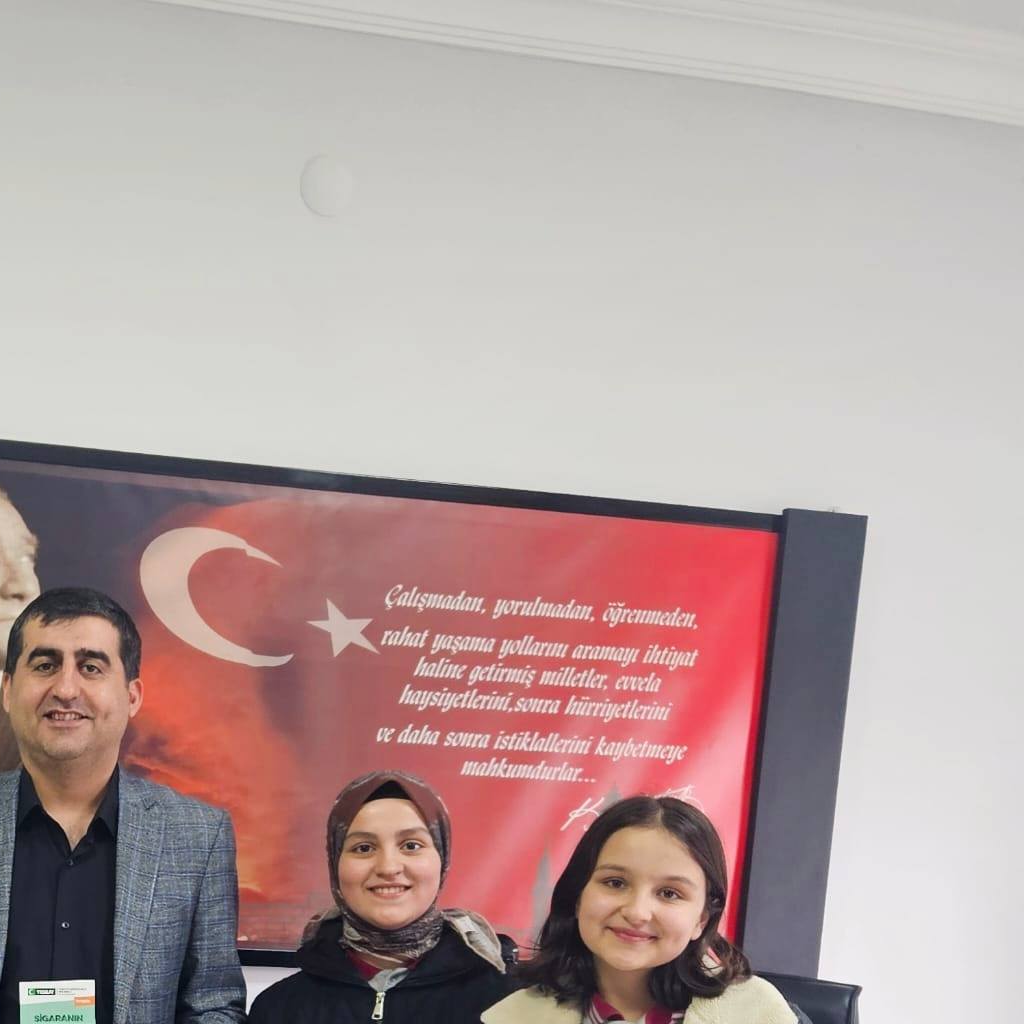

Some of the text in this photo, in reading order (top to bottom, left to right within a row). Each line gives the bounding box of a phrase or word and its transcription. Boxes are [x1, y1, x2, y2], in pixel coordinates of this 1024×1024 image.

[385, 584, 698, 630] Çalışmadan, yorulmadan, öğrenmeden,
[381, 625, 698, 671] rahat yaşama yollarını aramayı ihtiyat
[414, 656, 662, 692] haline getirmiş milletler, evvela
[564, 694, 673, 723] hürriyetlerini
[376, 723, 688, 765] ve daha sonra istiklallerini kaybetmeye
[460, 757, 597, 783] mahkumdurlar...
[34, 1013, 83, 1023] SİGARANIN
